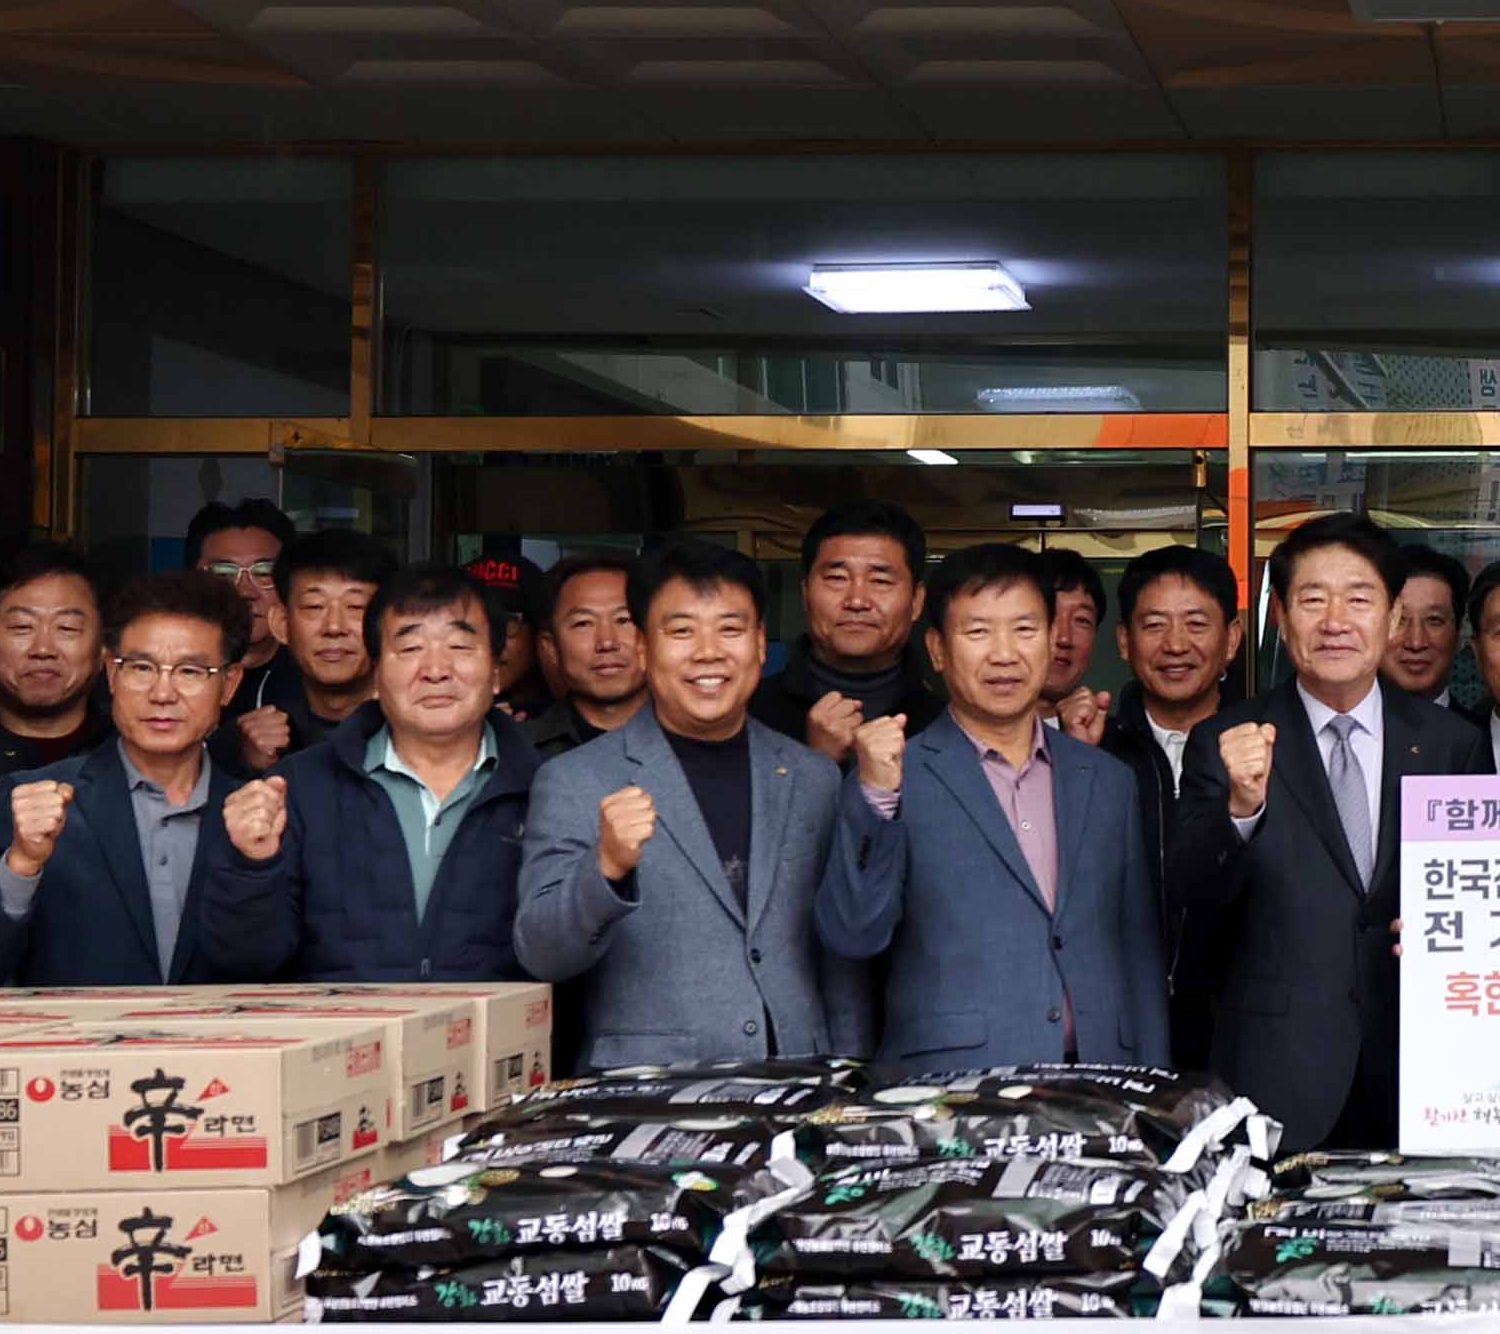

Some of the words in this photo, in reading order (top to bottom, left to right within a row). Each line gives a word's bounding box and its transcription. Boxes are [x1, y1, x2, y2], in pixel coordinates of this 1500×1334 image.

[59, 1079, 110, 1101] 농심
[124, 1069, 204, 1171] 辛
[203, 1113, 257, 1137] 라면
[984, 1133, 1088, 1160] 교동섬쌀
[515, 1210, 628, 1244] 교동섬쌀
[958, 1230, 1068, 1264] 교동섬쌀
[480, 1272, 591, 1308] 교동섬쌀
[947, 1288, 1059, 1319] 교동섬쌀
